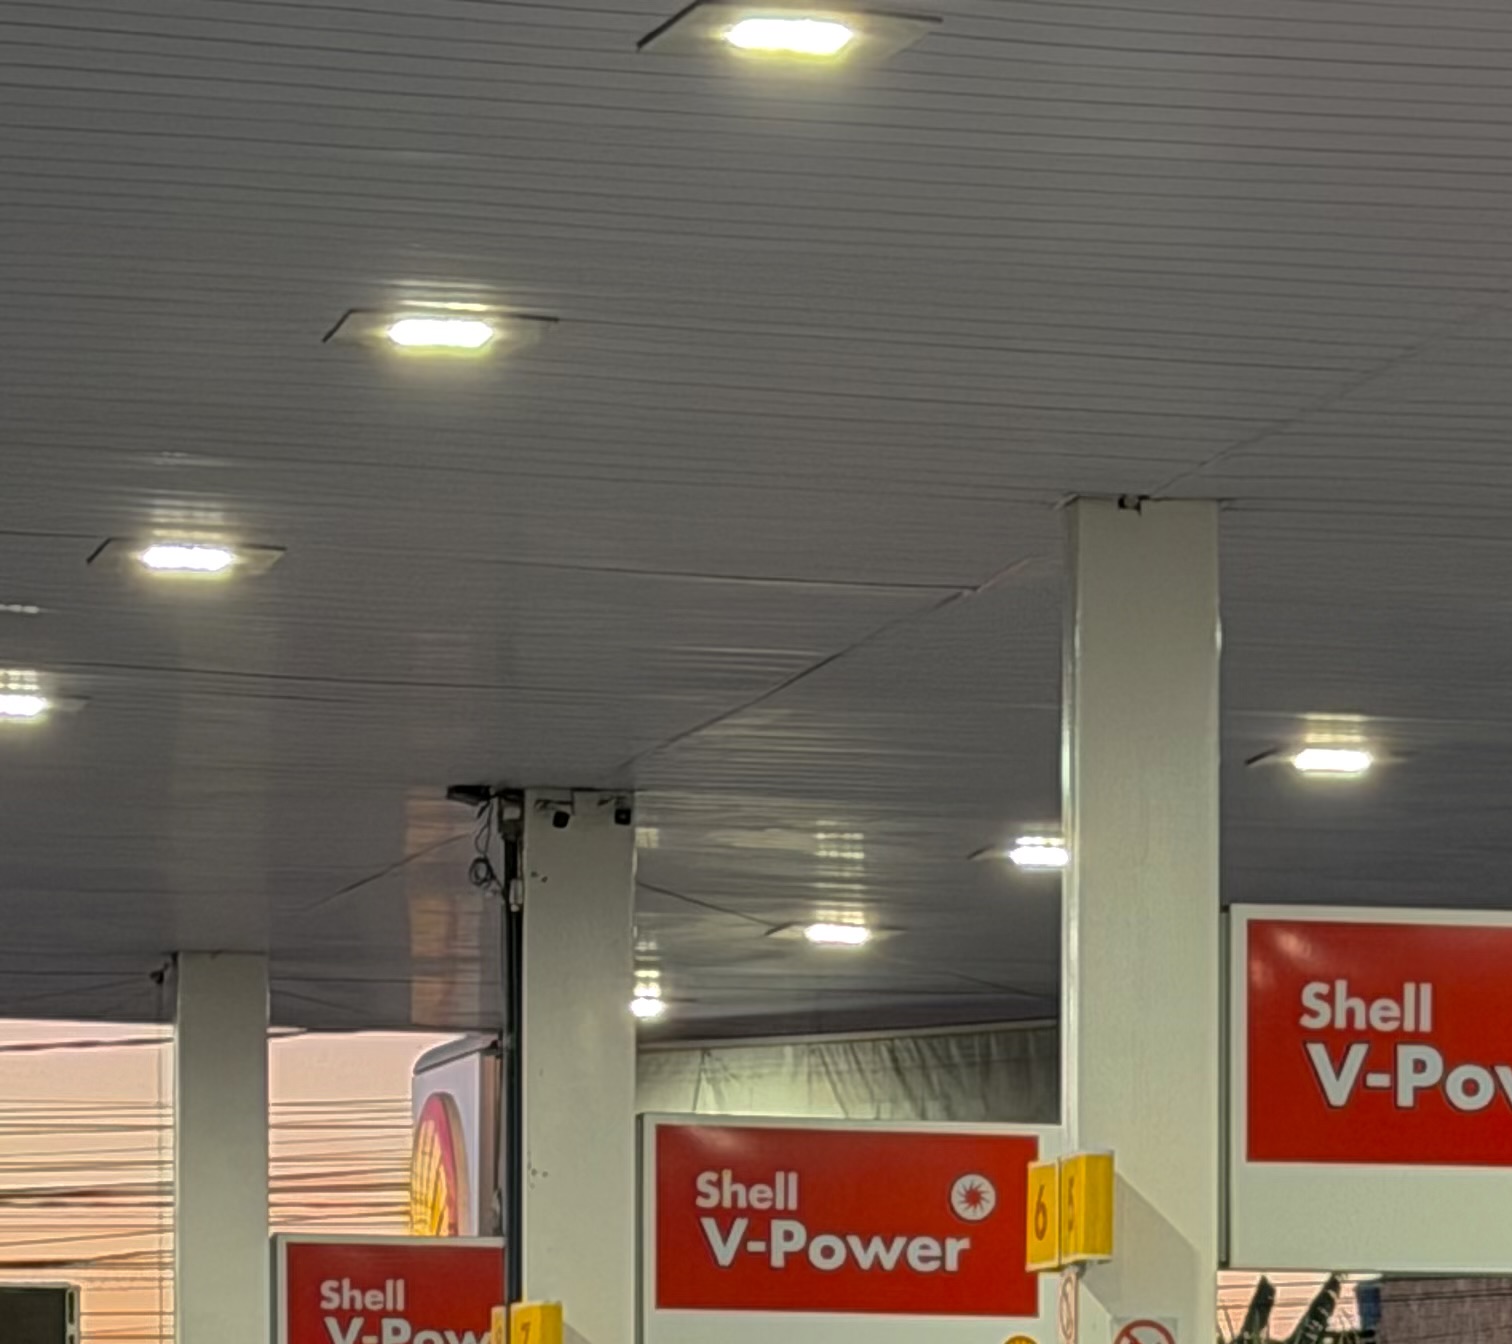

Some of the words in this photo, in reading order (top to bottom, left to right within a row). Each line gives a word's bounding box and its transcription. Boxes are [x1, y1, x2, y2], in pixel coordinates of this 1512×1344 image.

[1299, 981, 1432, 1033] Shell
[695, 1169, 798, 1211] Shell
[1034, 1183, 1048, 1241] 6
[701, 1217, 971, 1272] V-Power
[320, 1277, 405, 1312] Shell
